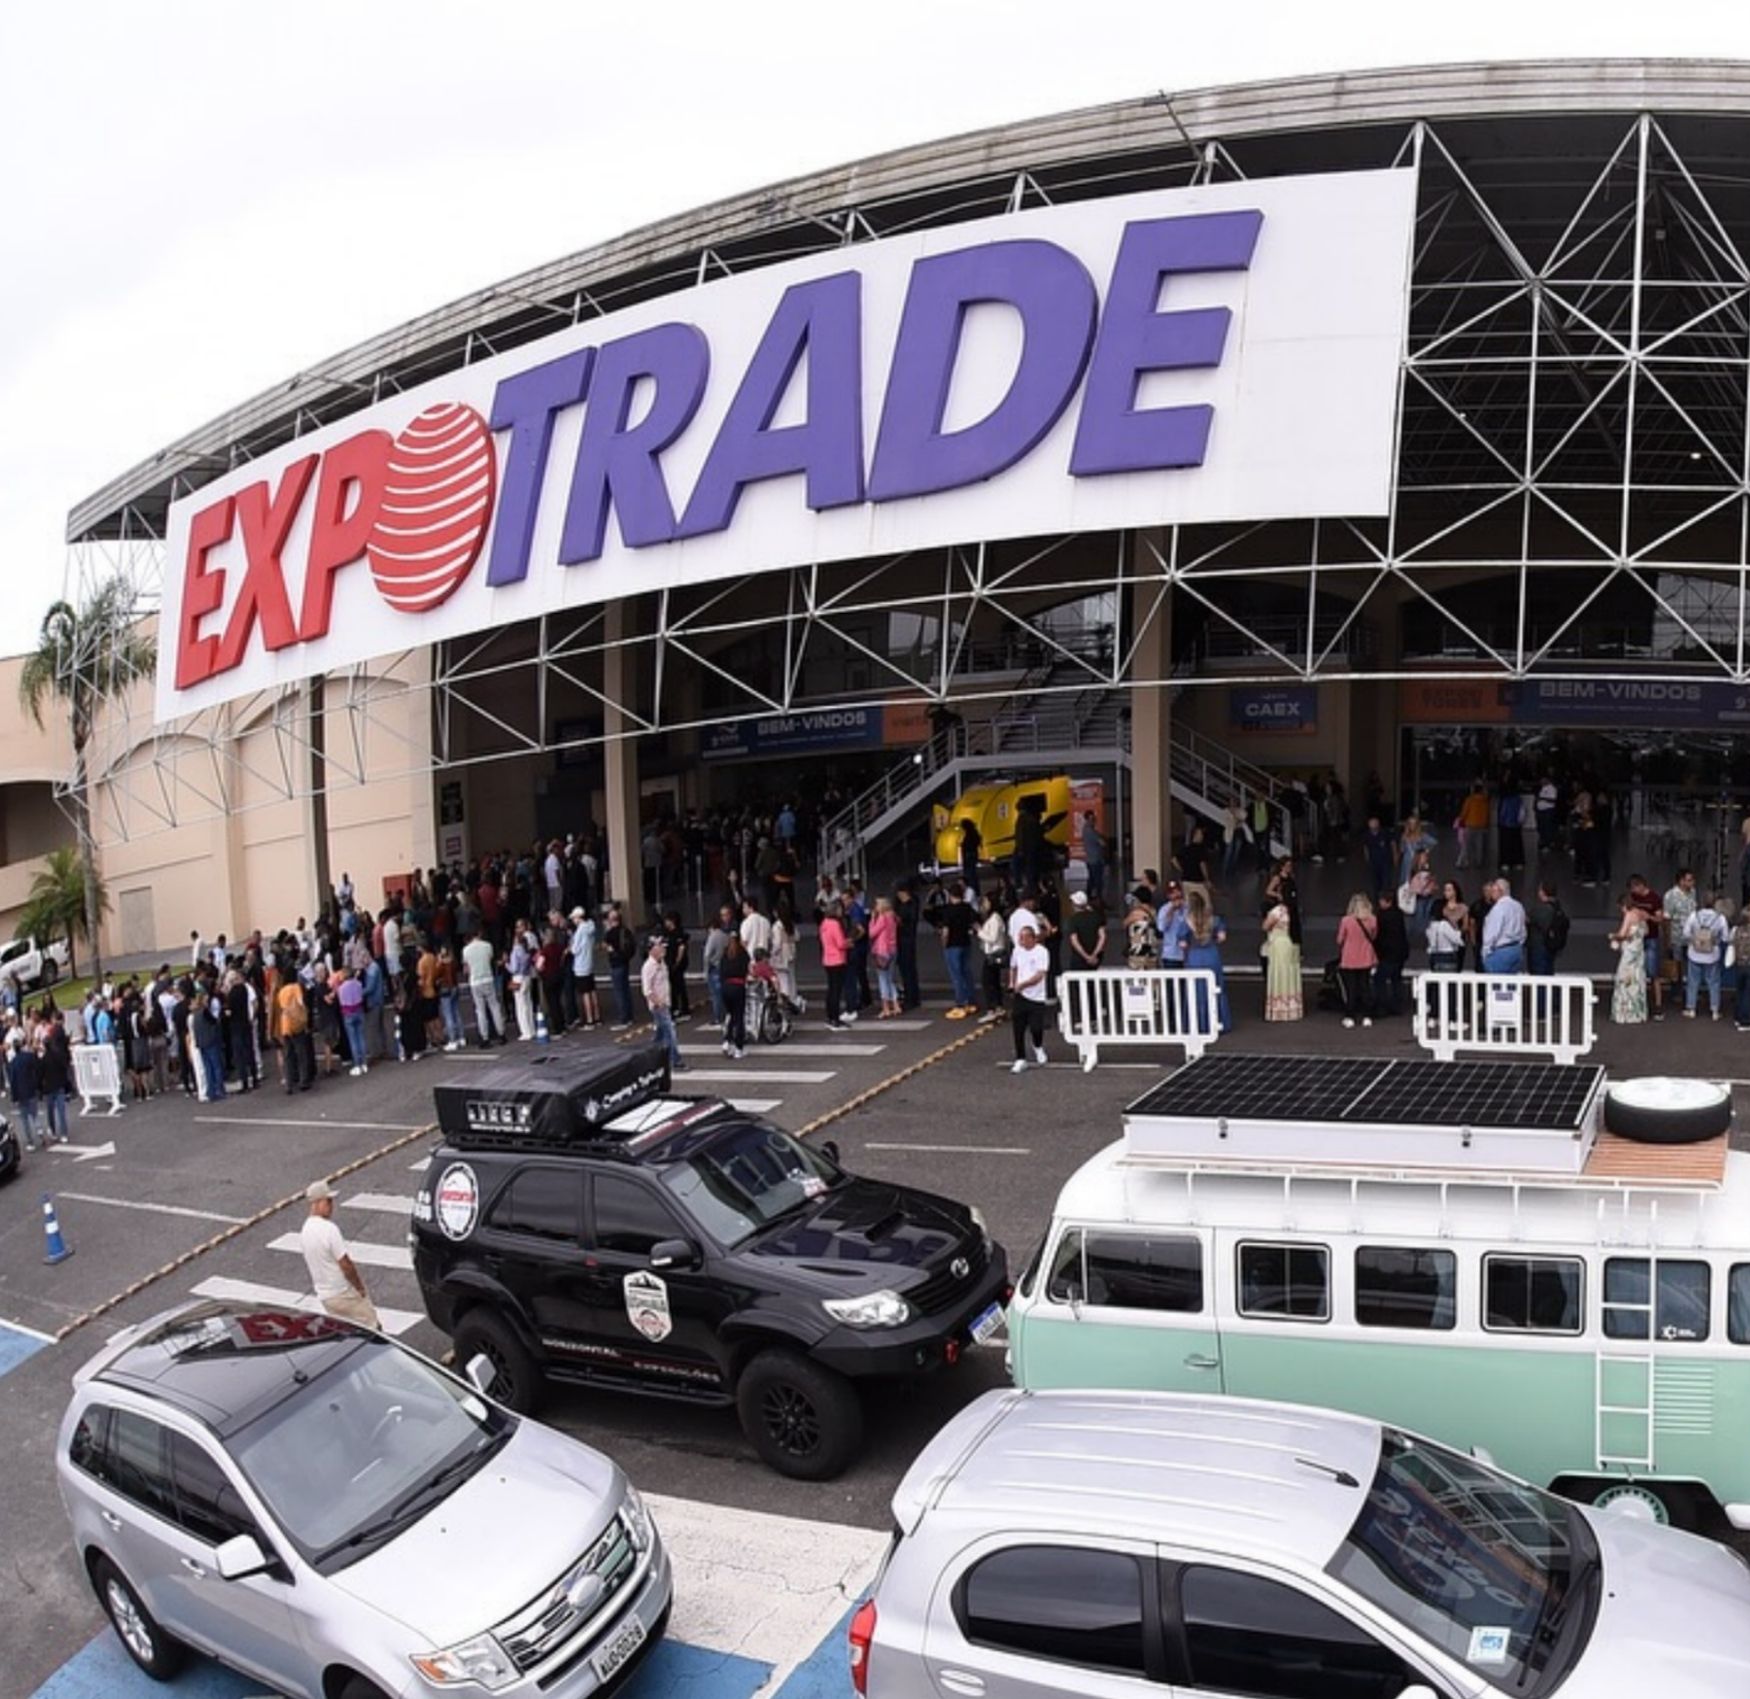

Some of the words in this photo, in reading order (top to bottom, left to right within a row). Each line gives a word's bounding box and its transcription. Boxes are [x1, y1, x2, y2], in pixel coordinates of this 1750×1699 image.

[174, 208, 1264, 690] EXPOTRADE
[1539, 680, 1701, 700] BEM-VINDOS
[757, 710, 867, 736] BEM-VINDOS
